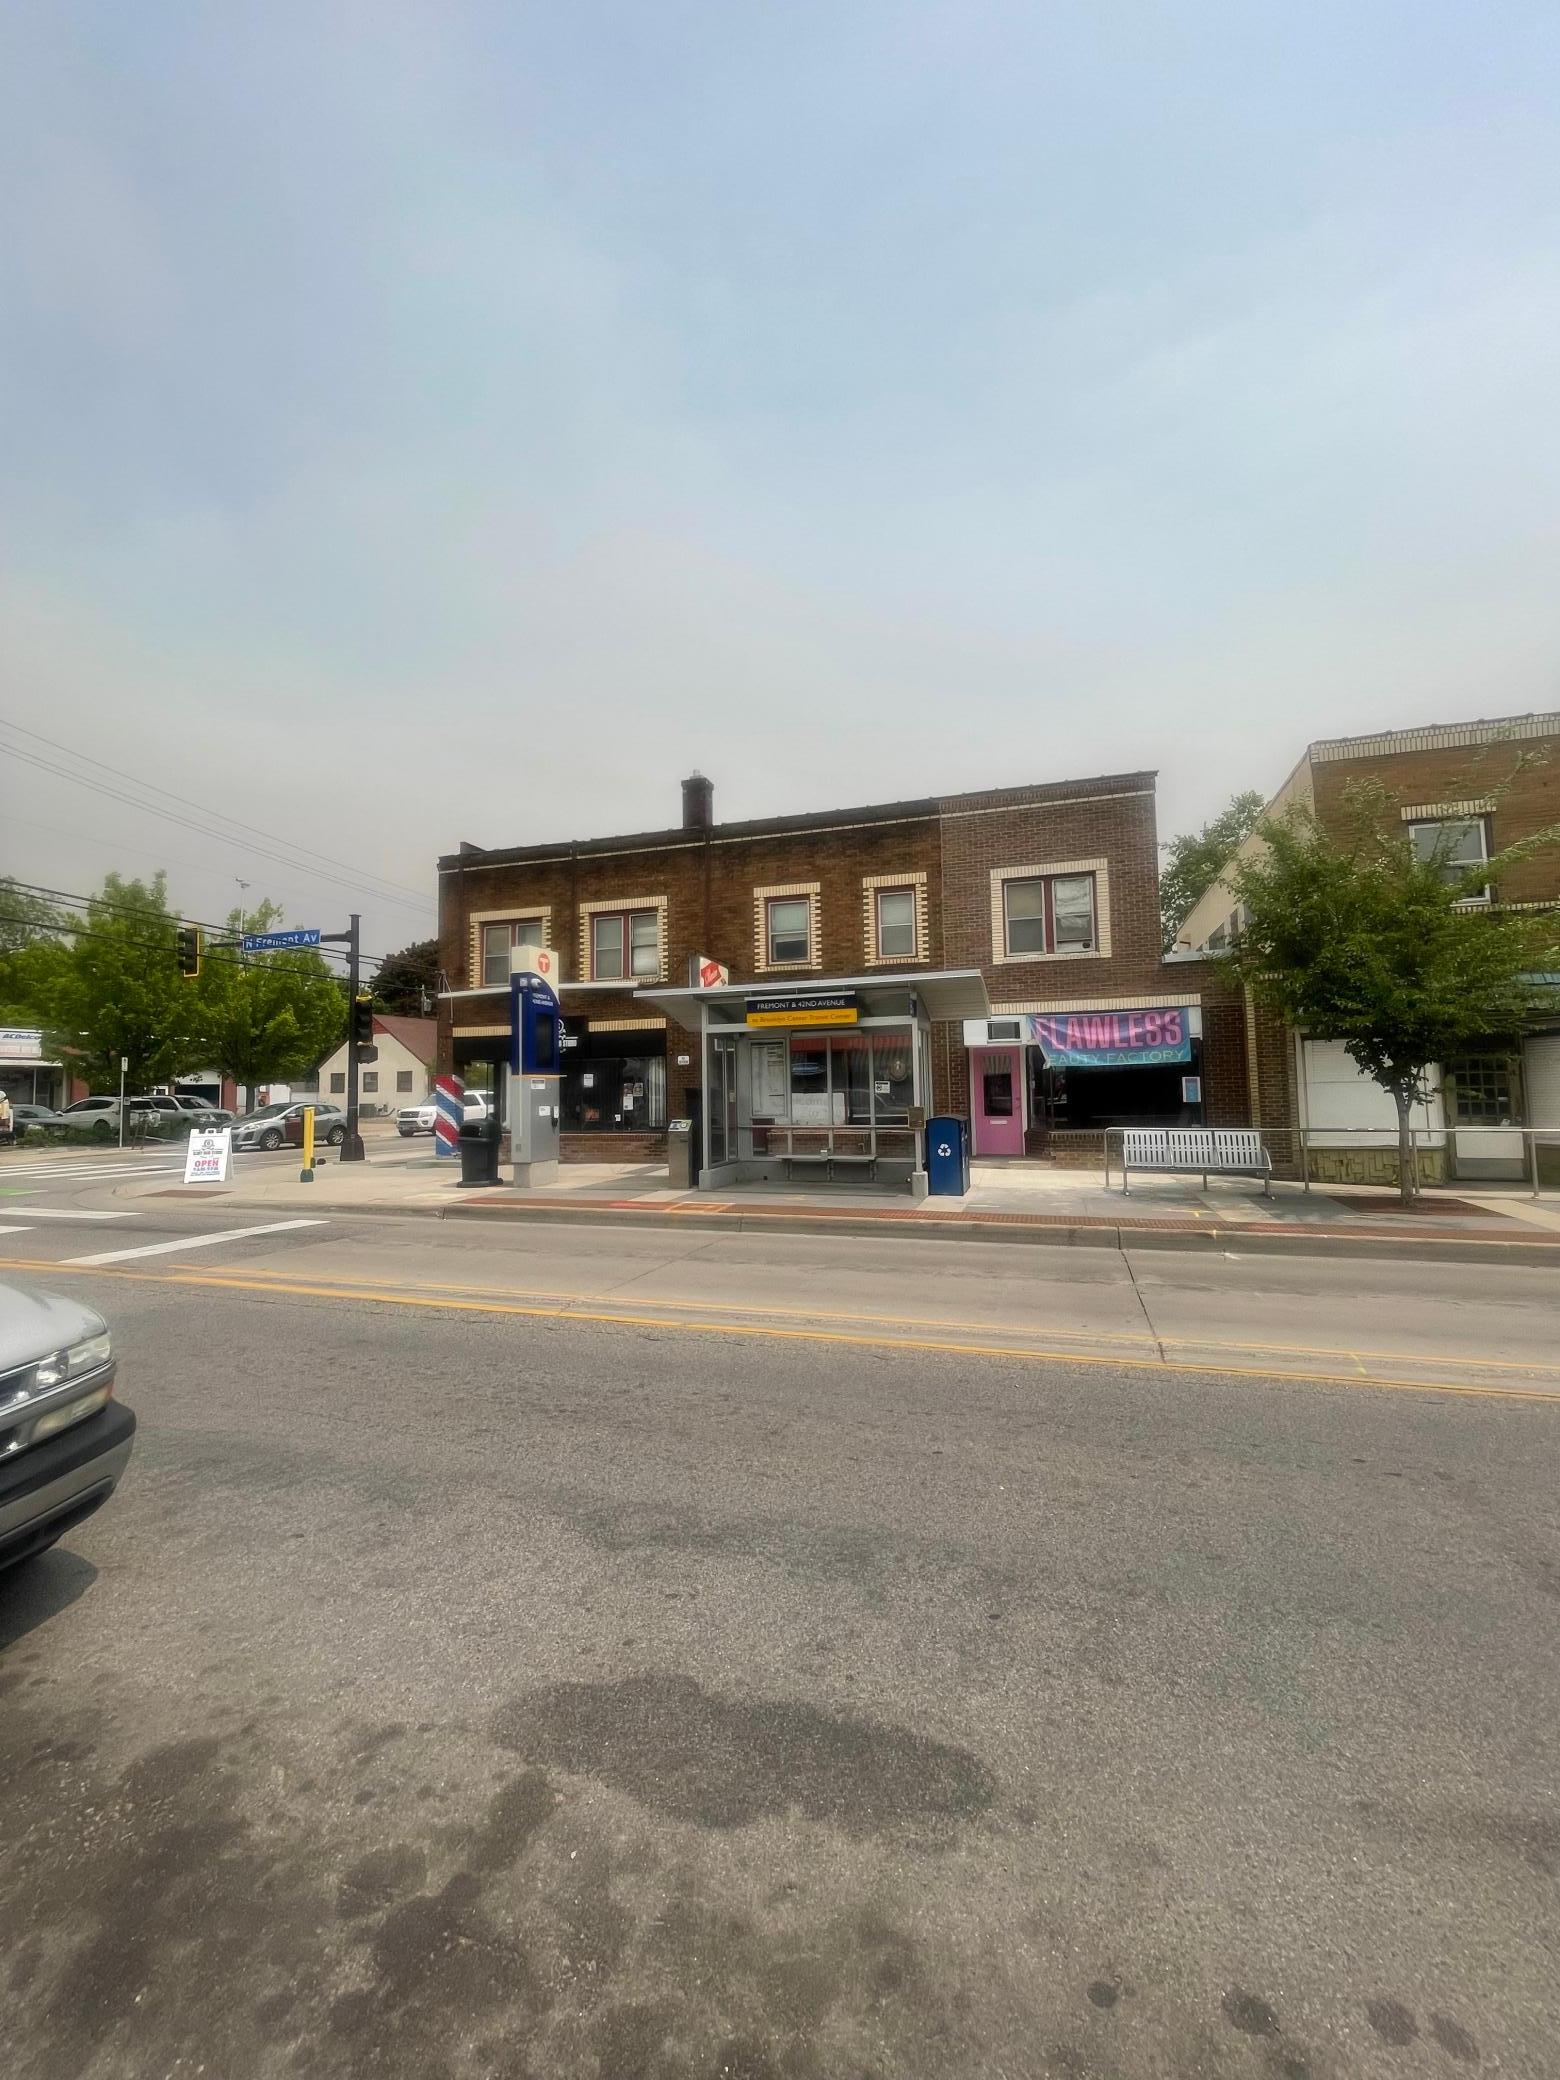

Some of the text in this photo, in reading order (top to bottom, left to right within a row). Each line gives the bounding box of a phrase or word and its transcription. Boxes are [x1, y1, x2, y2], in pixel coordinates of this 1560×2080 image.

[246, 932, 317, 949] N Fremont Av
[756, 1001, 790, 1010] FREMONT
[798, 1000, 816, 1008] 42ND
[818, 999, 845, 1007] AVENUE
[1036, 1010, 1183, 1050] FLAWLESS
[1048, 1049, 1184, 1066] EAUTY FACTORY
[195, 1159, 219, 1168] OPEN
